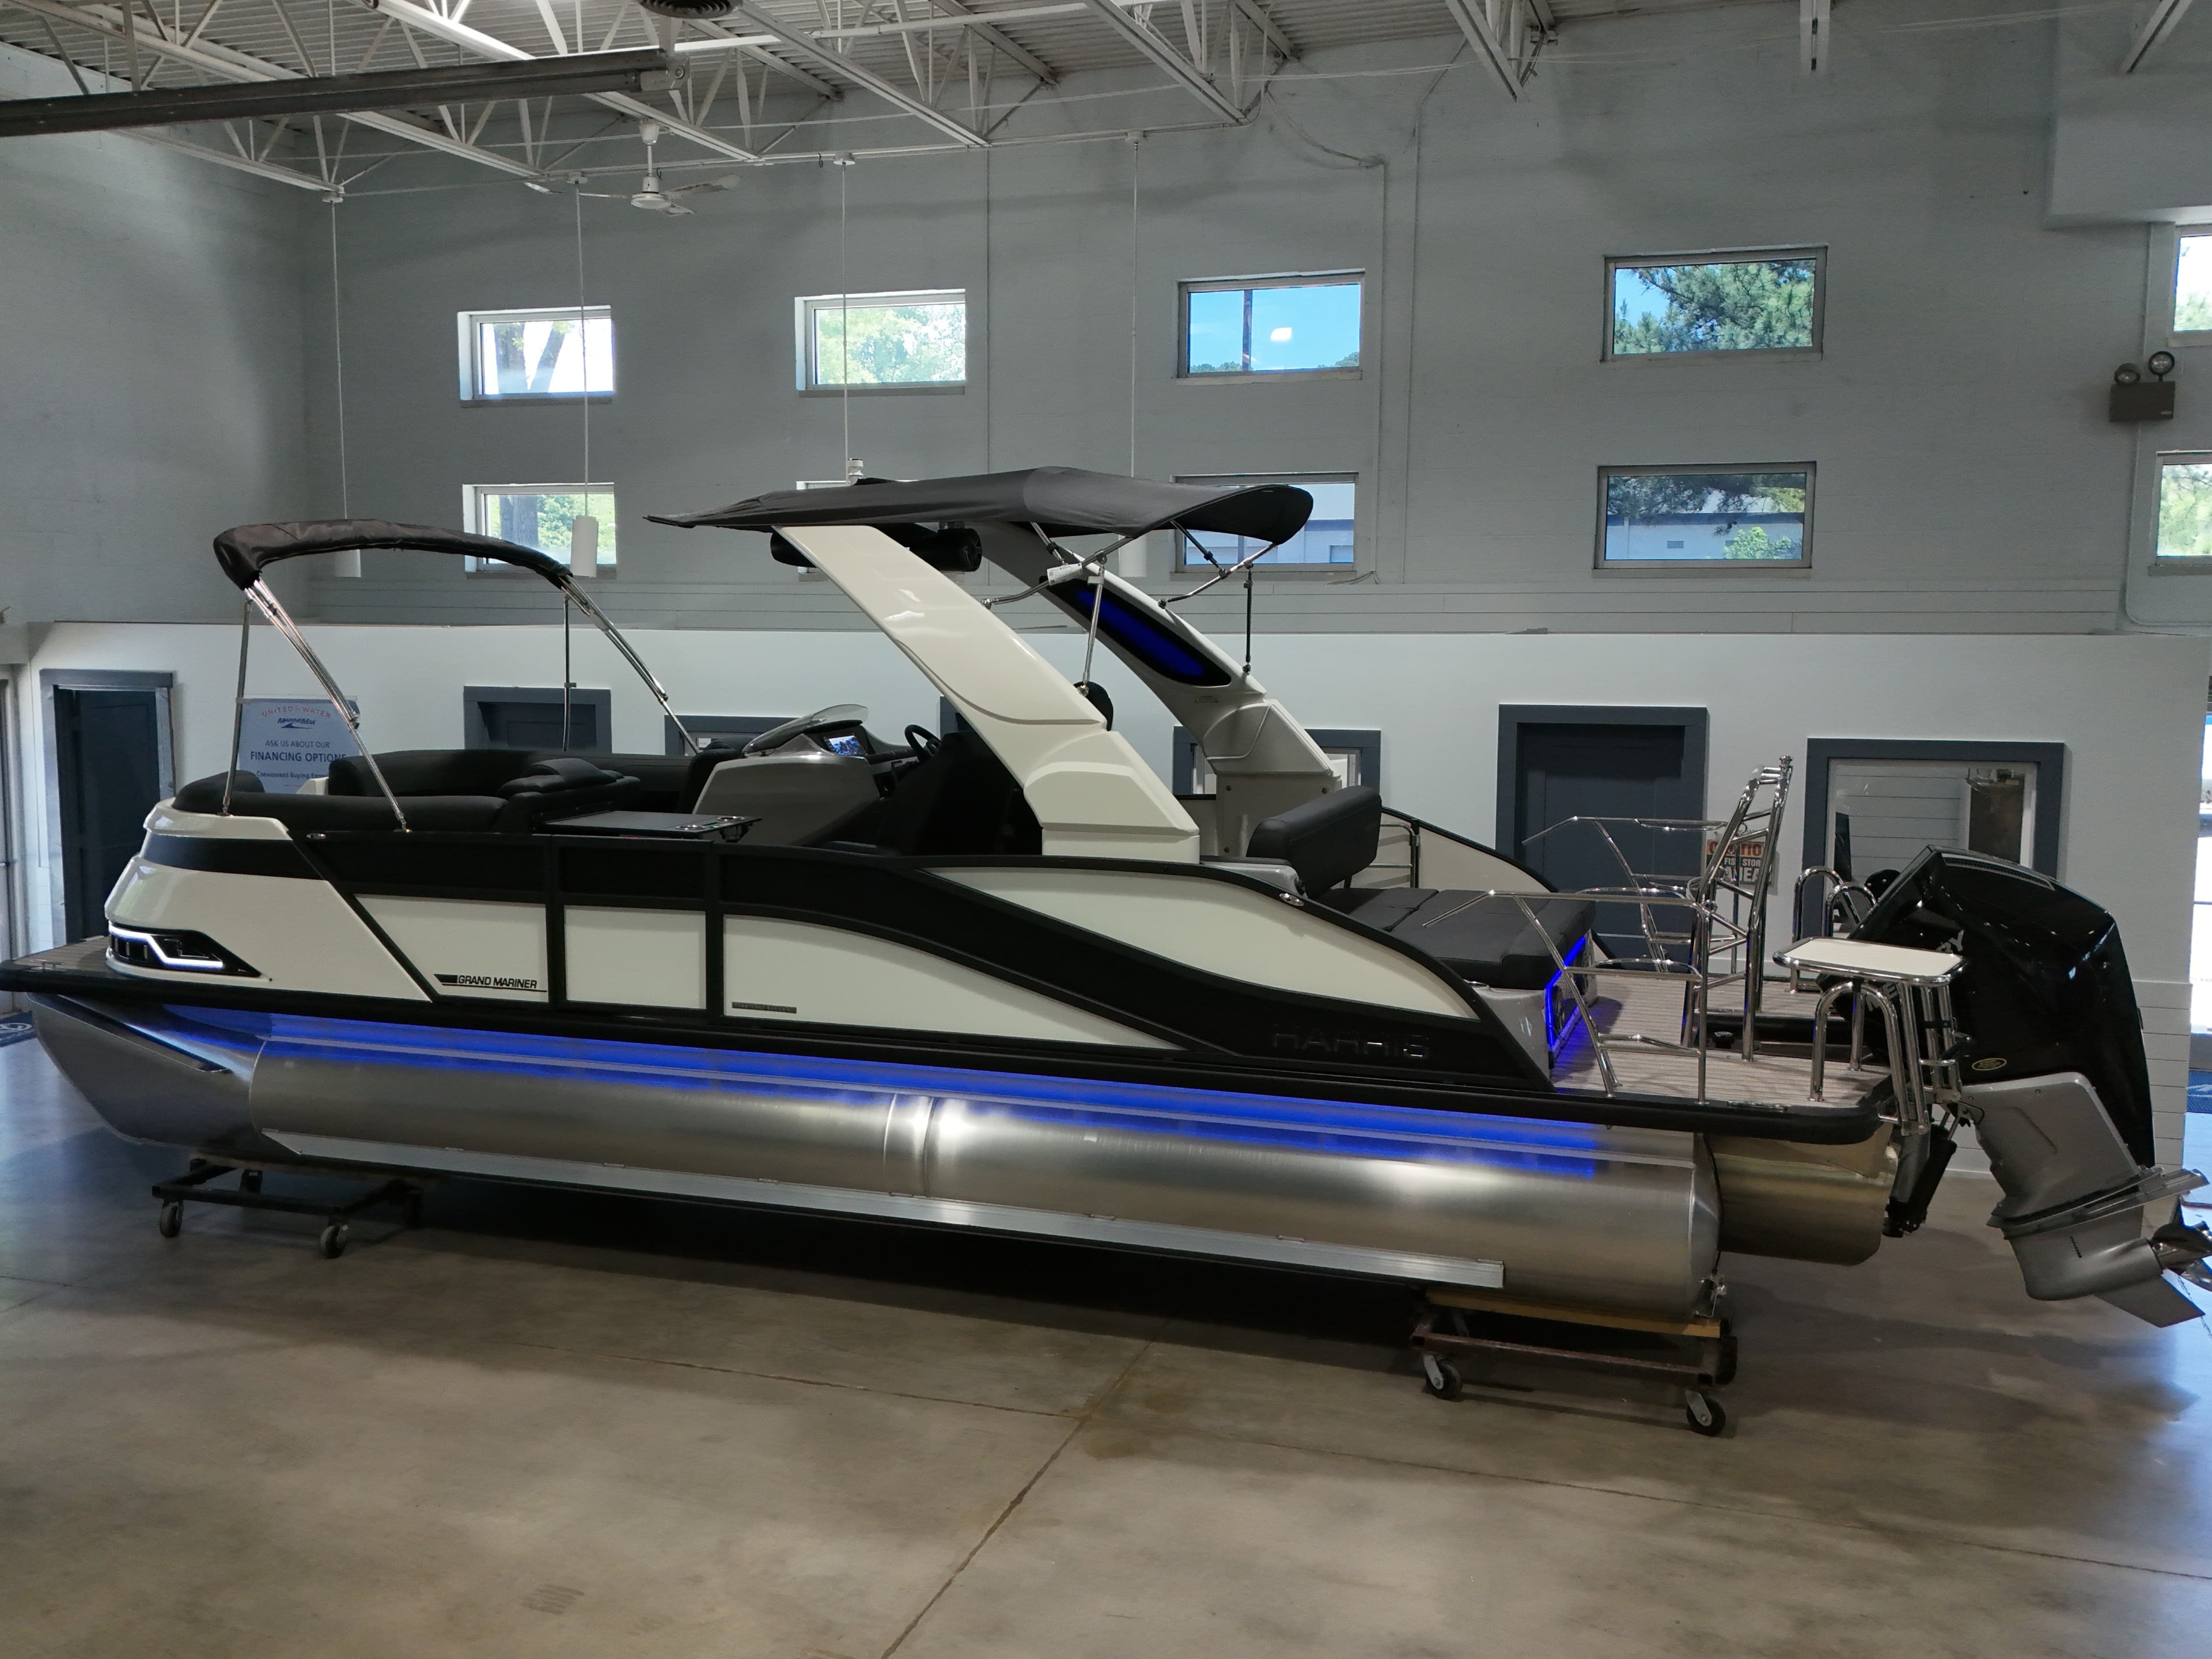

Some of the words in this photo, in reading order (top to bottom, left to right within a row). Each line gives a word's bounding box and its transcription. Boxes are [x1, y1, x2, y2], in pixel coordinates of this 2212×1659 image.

[262, 706, 293, 717] UNITED
[302, 706, 331, 718] WATER
[250, 751, 302, 762] FINANCING
[458, 975, 491, 986] GRAND
[493, 976, 537, 989] MARINER
